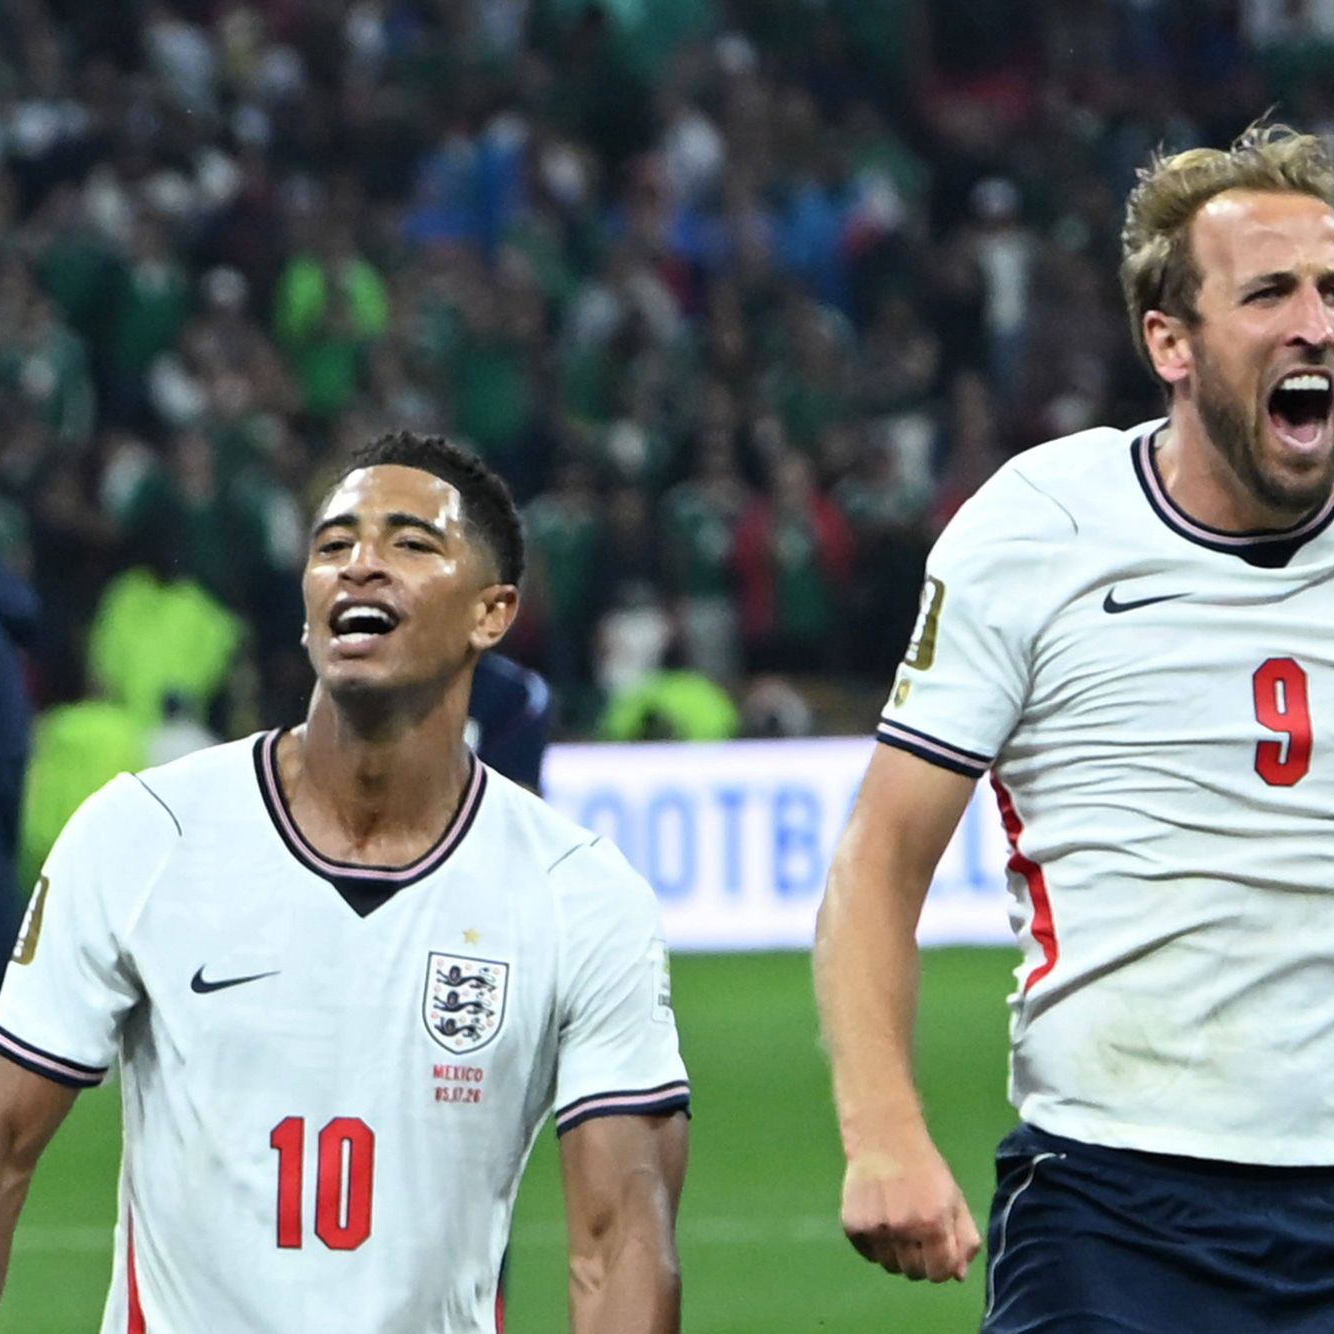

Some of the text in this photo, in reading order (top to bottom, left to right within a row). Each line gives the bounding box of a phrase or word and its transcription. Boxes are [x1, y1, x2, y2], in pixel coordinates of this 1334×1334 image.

[1252, 656, 1313, 787] 9
[570, 781, 1004, 904] OOTBL
[432, 1065, 484, 1083] MEXICO
[269, 1115, 376, 1251] 10
